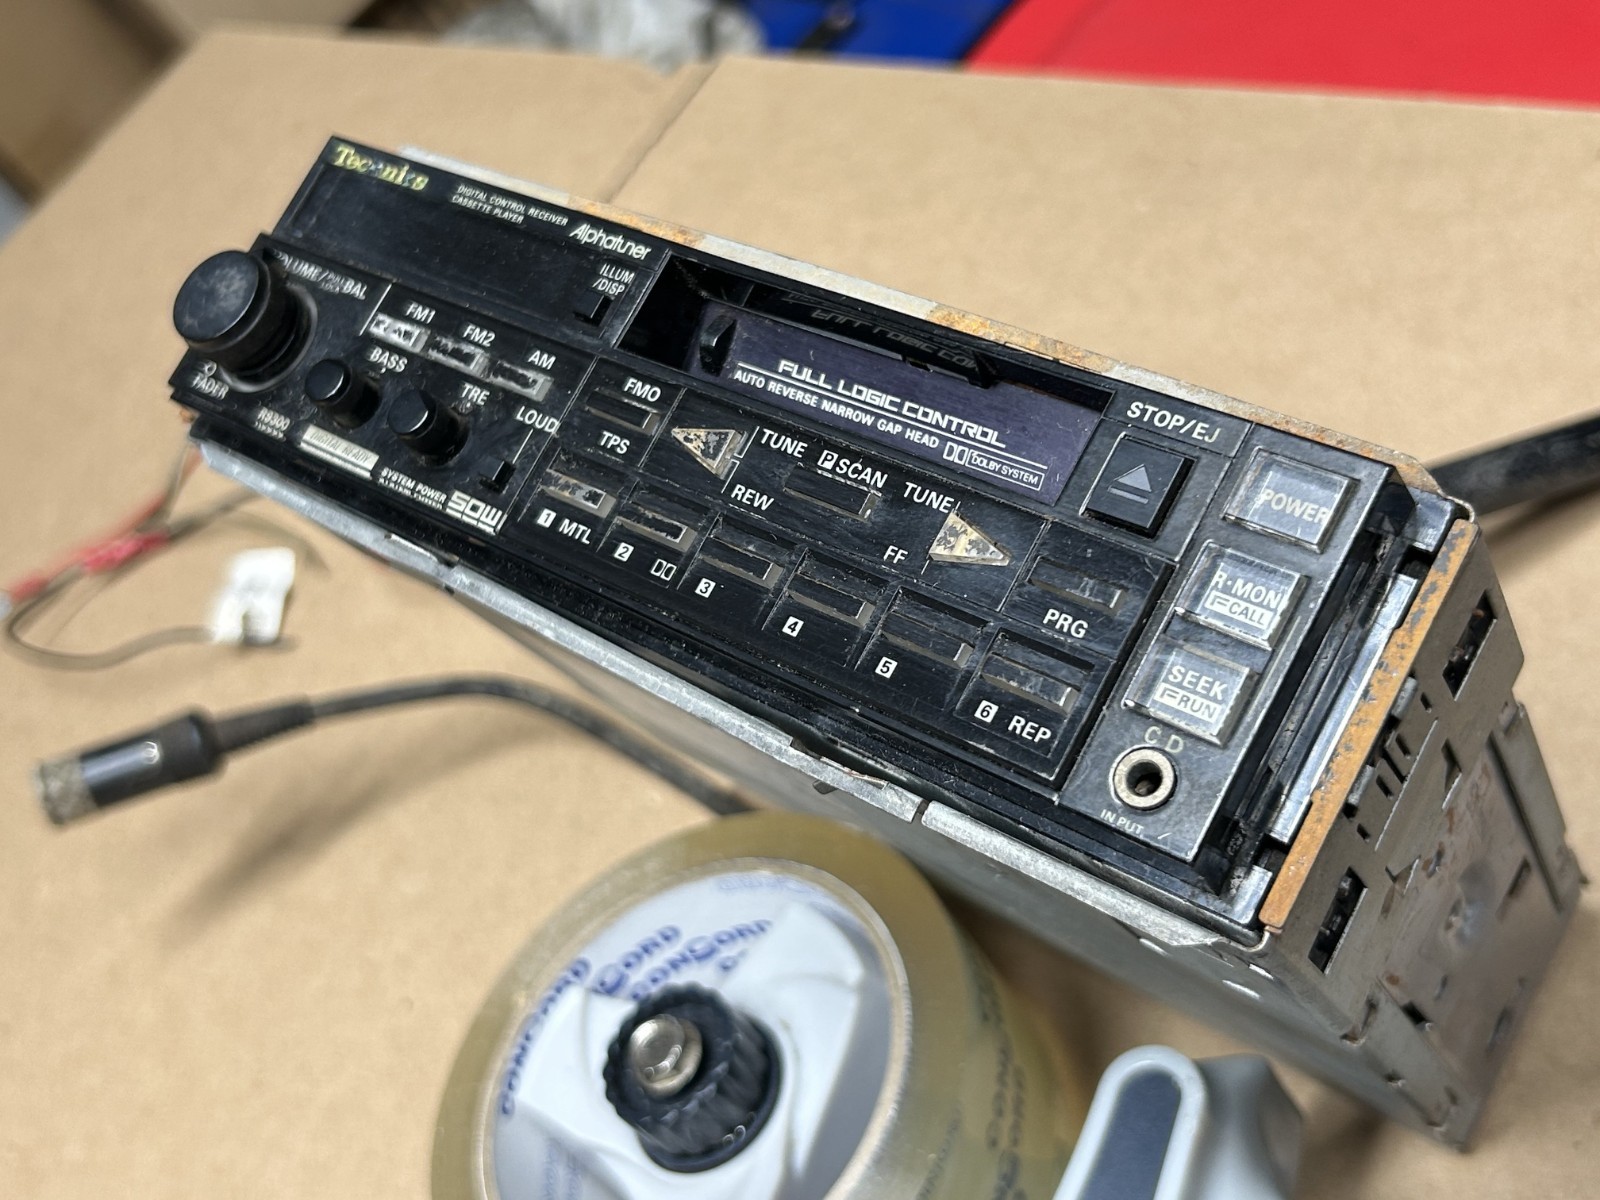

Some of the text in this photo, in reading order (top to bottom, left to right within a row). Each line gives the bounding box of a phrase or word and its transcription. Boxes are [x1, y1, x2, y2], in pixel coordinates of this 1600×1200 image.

[452, 195, 525, 225] CASSETTE PLAYER
[456, 184, 569, 227] DIGITAL CONTROL RECEIVER
[569, 223, 651, 260] Alphatuner
[592, 278, 625, 296] /DISP
[599, 263, 635, 284] ILLUM
[341, 277, 367, 300] BAL
[405, 302, 436, 324] FM1
[462, 323, 496, 347] FM2
[367, 347, 408, 373] BASS
[527, 349, 557, 370] AM
[459, 382, 490, 405] TRE
[623, 376, 662, 402] FMO
[733, 369, 940, 449] AUTO REVERSE NARROW GAP HEAD
[778, 359, 1006, 448] FULL LOGIC CONTROL
[514, 405, 559, 434] LOUD
[1127, 401, 1222, 444] STOP/EJ
[599, 430, 630, 454] TPS
[760, 428, 809, 459] TUNE
[835, 457, 888, 489] SCAN
[971, 453, 1039, 485] DOLBY SYSTEM
[381, 466, 448, 503] SYSTEM POWER
[730, 483, 775, 511] REW
[903, 481, 955, 514] TUNE
[1260, 488, 1330, 525] POWER
[558, 518, 593, 545] MTL
[882, 545, 909, 564] FF
[1042, 608, 1089, 639] PRG
[1228, 601, 1268, 626] CALL
[1167, 664, 1228, 700] SEEK
[1177, 695, 1217, 719] RUN
[1006, 714, 1052, 744] REP
